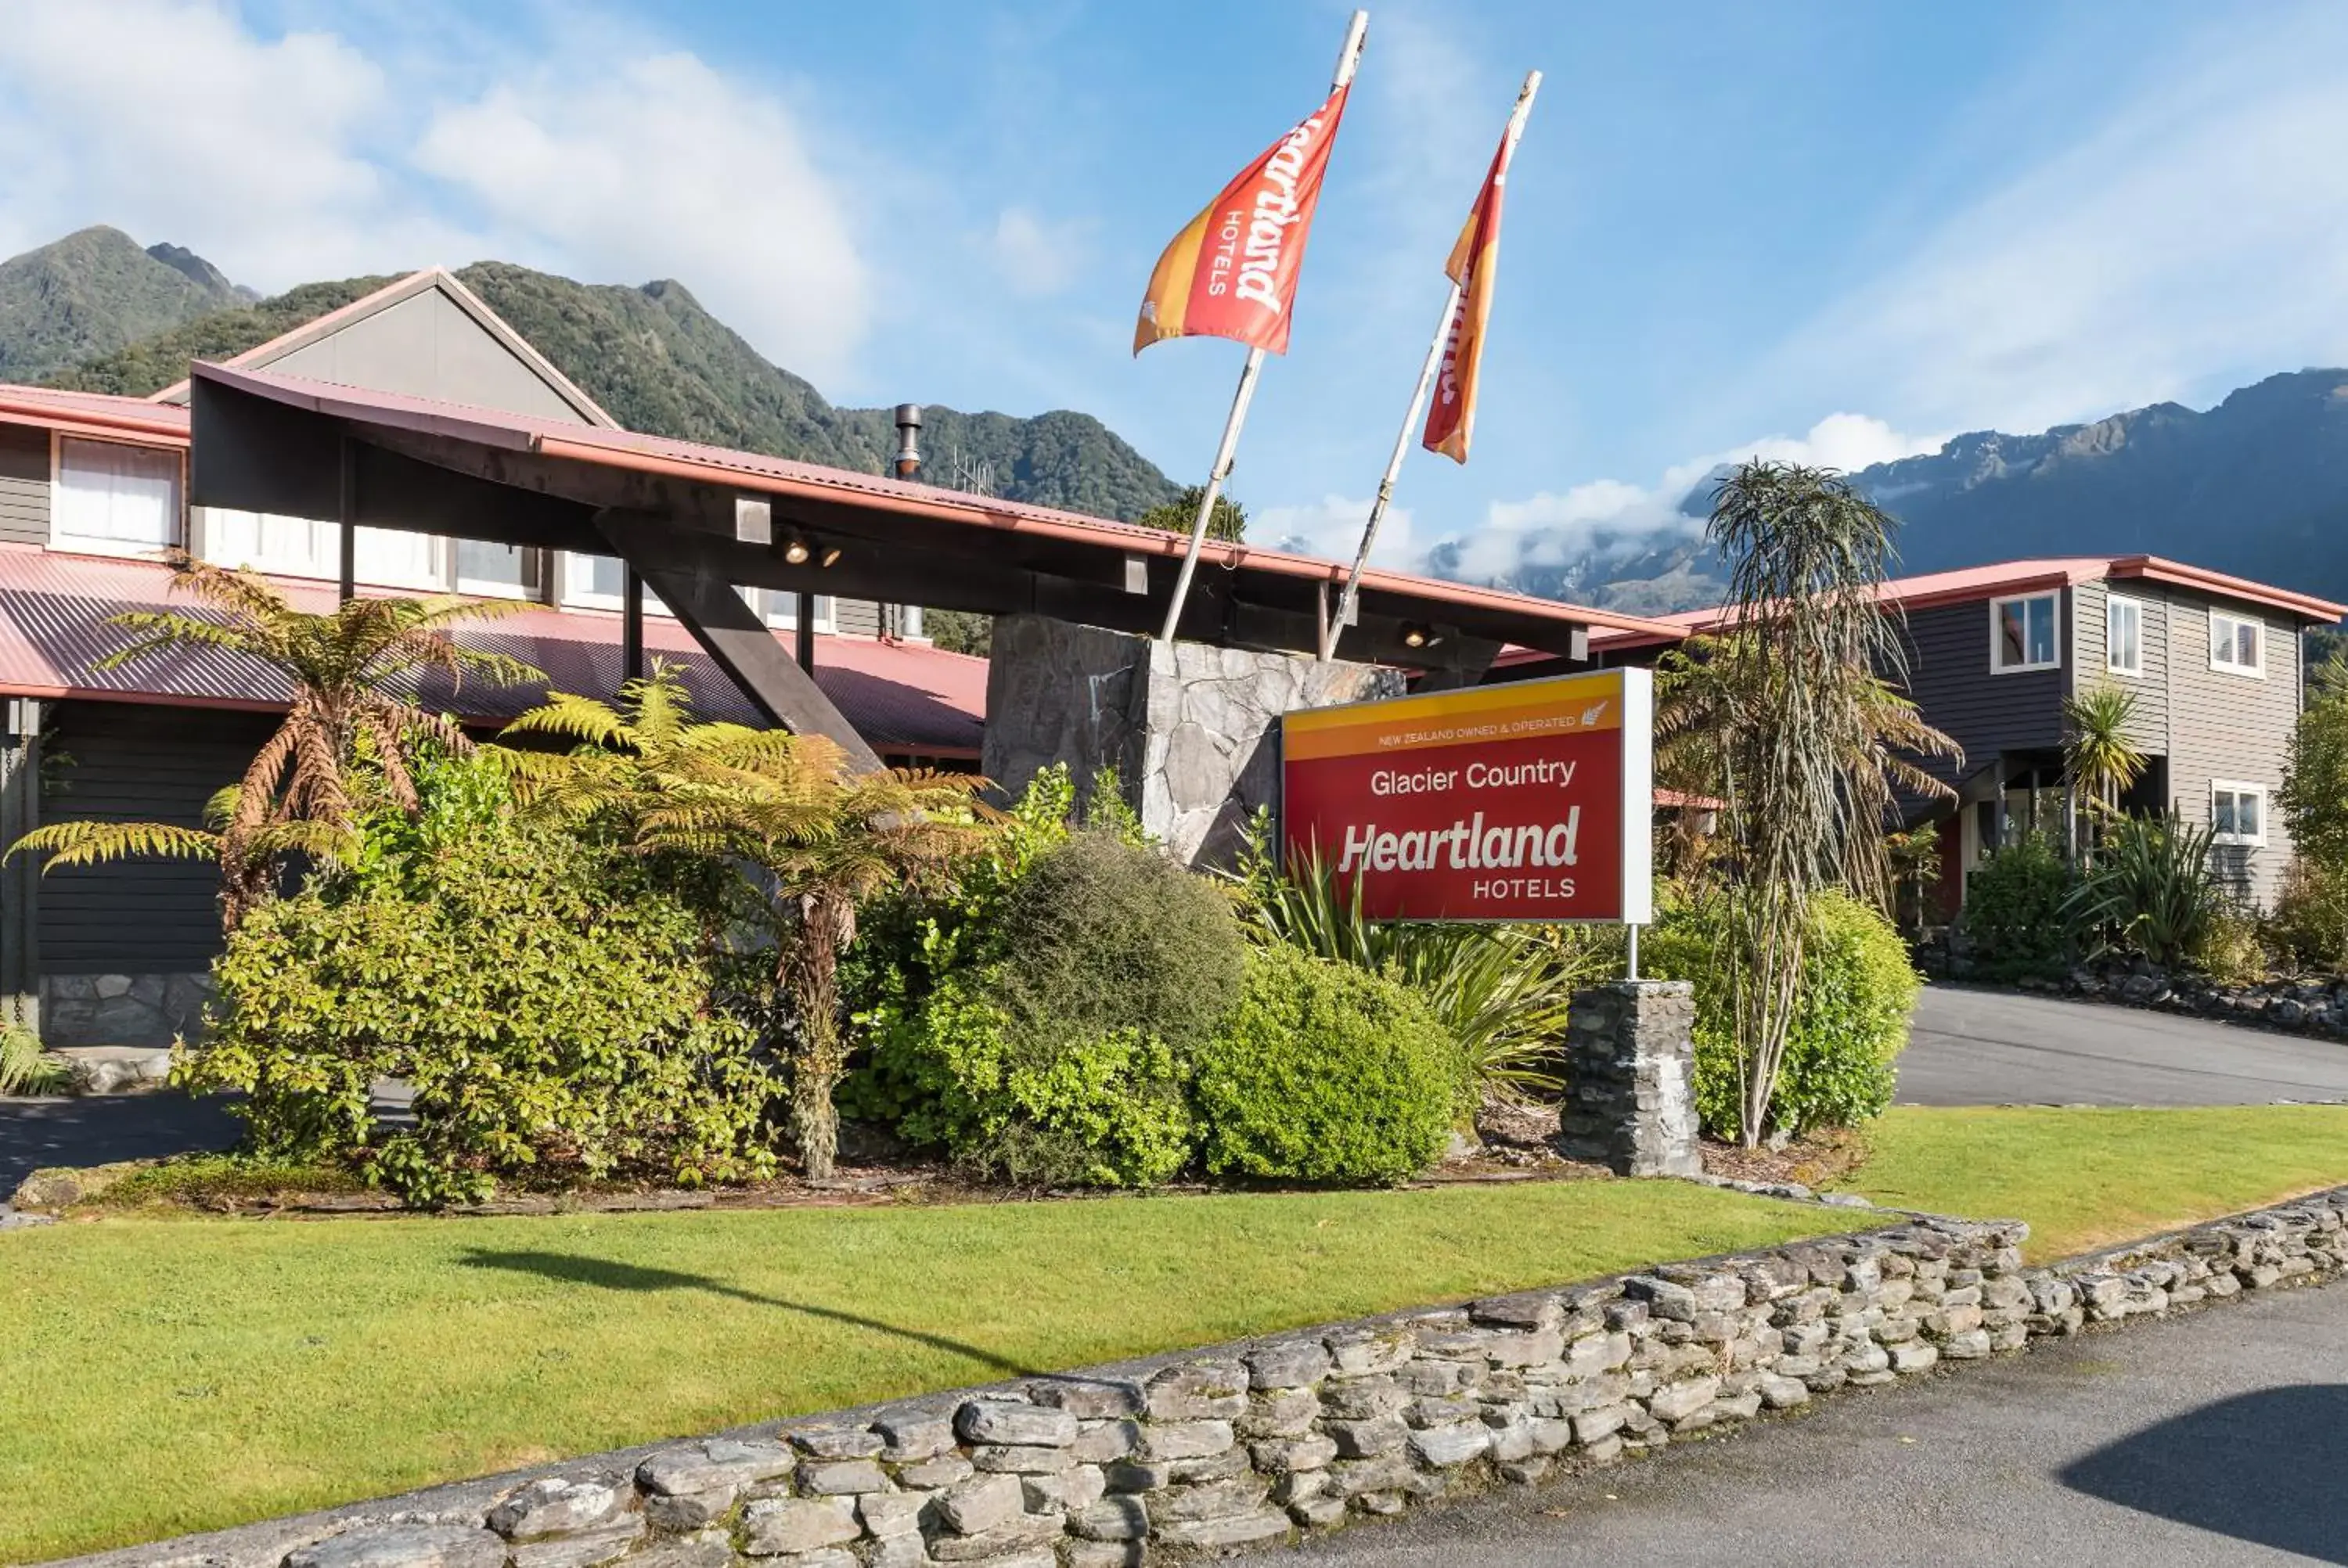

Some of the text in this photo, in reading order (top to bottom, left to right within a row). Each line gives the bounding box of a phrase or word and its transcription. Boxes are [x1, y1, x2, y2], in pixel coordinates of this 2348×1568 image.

[1208, 210, 1245, 297] HOTELS
[1378, 716, 1576, 746] NEW ZEALAND OWNED & OPERATED
[1370, 758, 1577, 796] Glacier Country
[1338, 805, 1580, 872] Heartland
[1474, 879, 1576, 899] HOTELS
